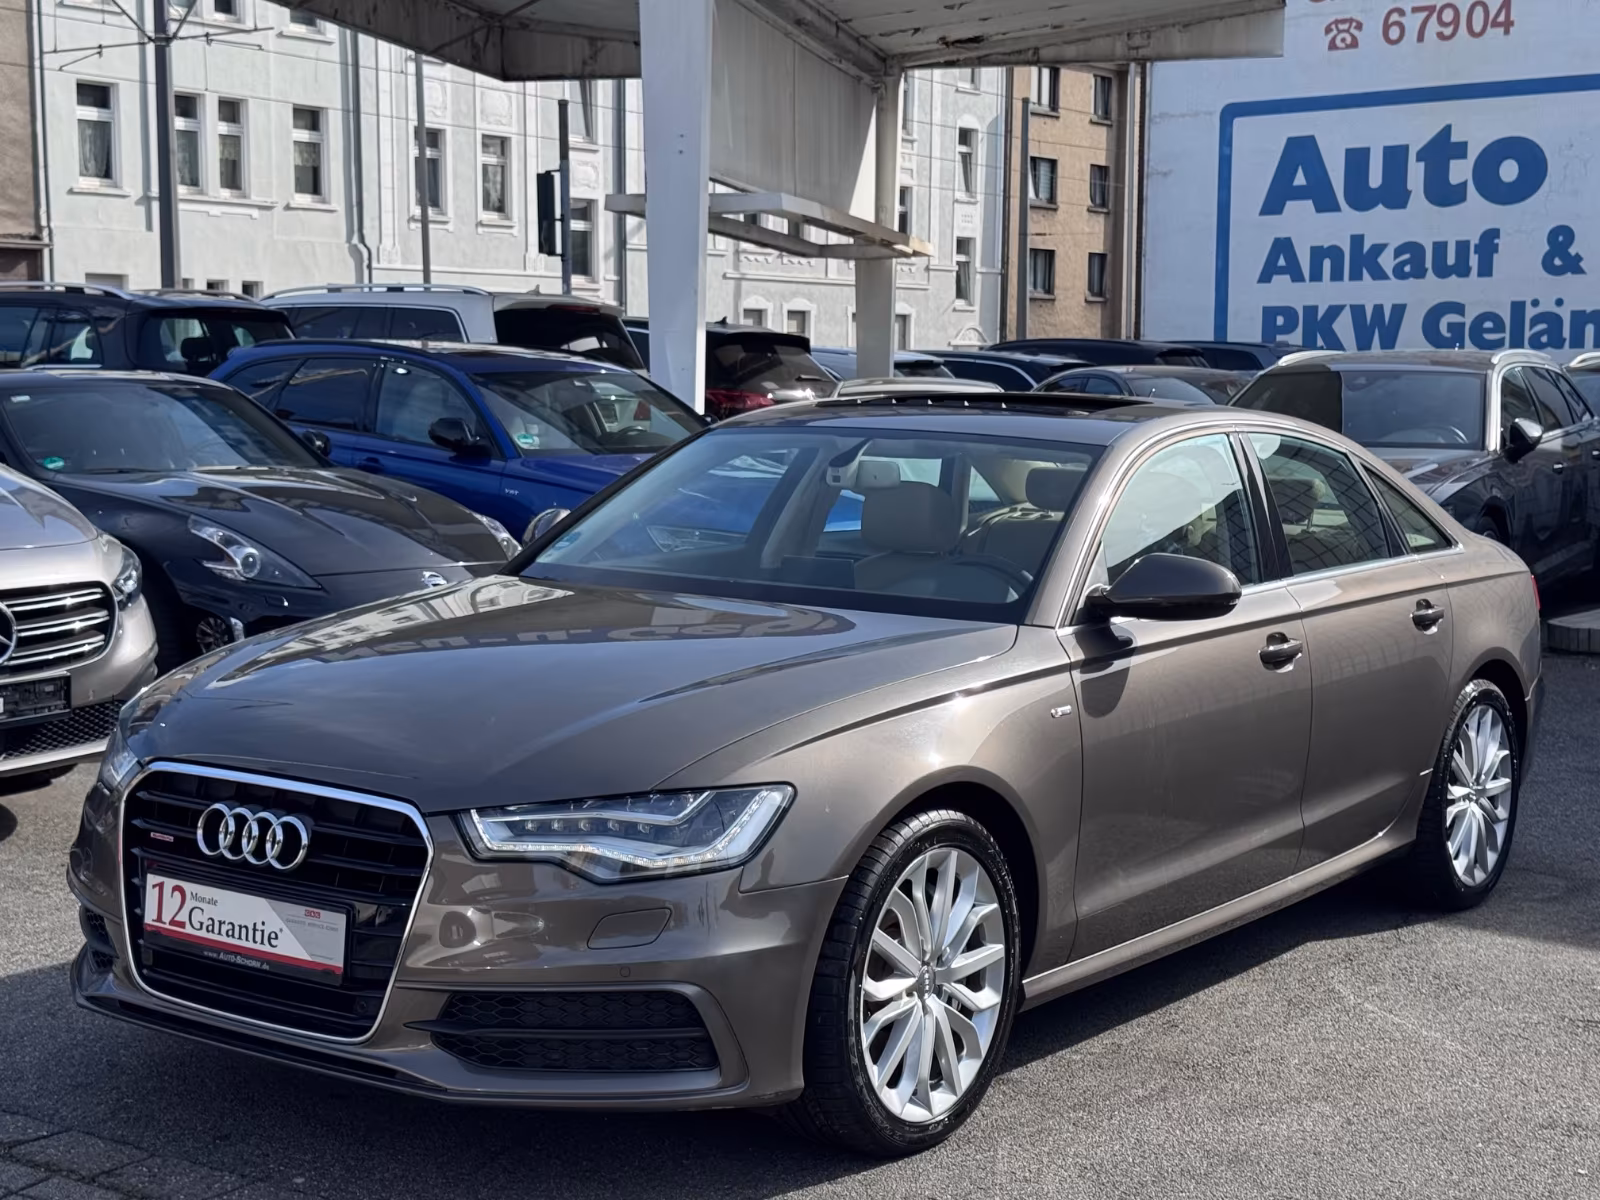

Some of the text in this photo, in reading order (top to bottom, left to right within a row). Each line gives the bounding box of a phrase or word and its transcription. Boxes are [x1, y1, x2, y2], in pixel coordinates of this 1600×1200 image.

[1382, 0, 1514, 46] 67904
[1258, 123, 1548, 216] Auto
[1256, 224, 1587, 284] Ankauf &
[1261, 302, 1408, 352] PKW
[151, 880, 187, 930] 12
[189, 890, 219, 907] Monate
